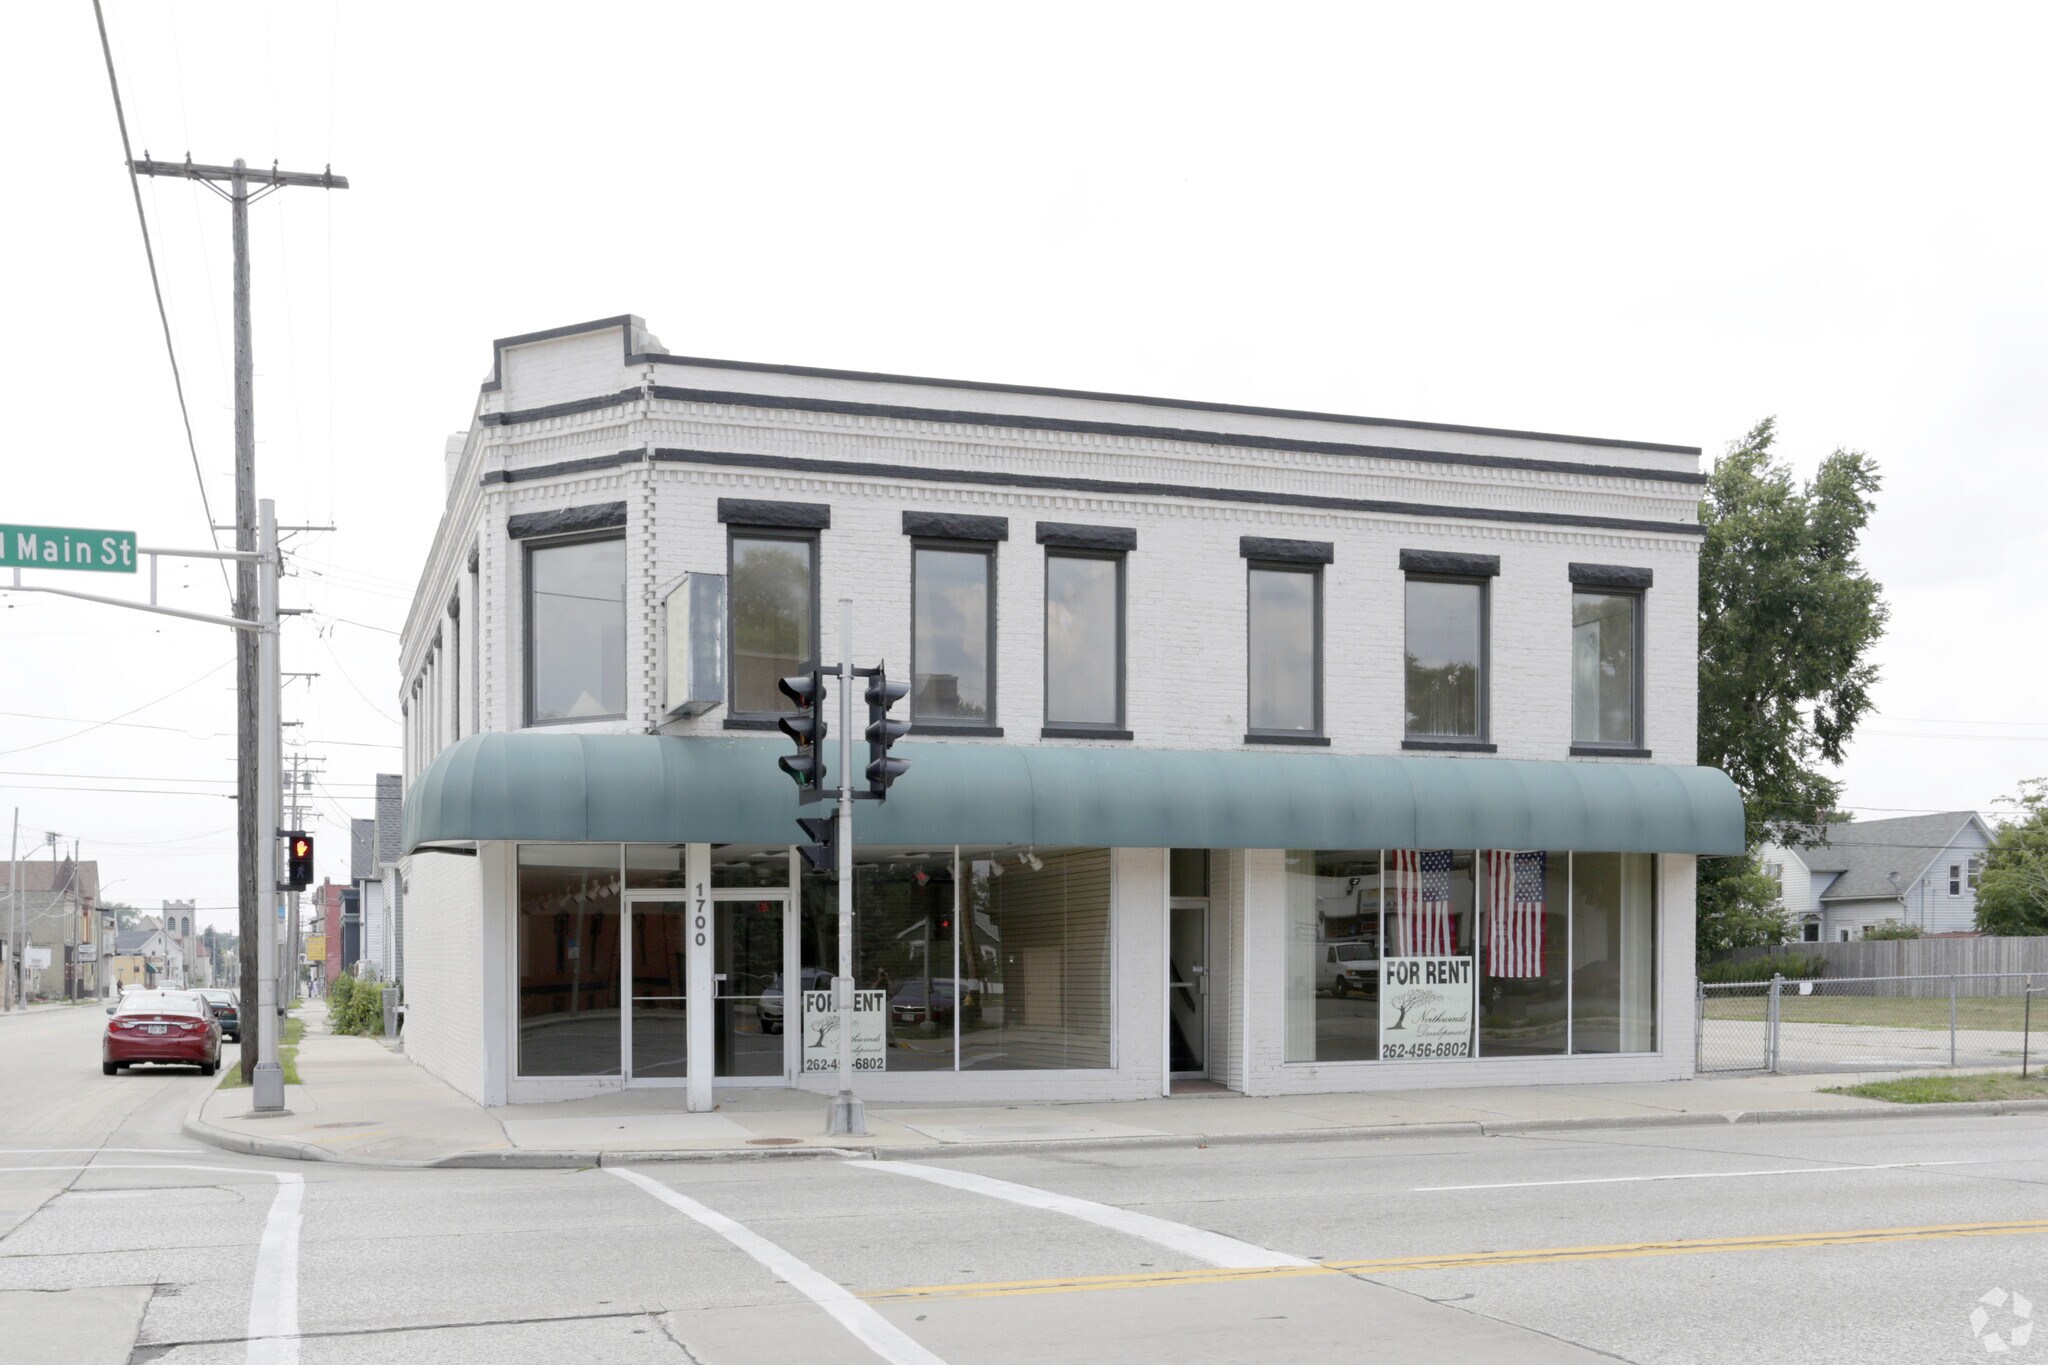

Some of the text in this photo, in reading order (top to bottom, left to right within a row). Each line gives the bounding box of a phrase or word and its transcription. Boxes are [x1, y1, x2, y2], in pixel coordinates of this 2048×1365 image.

[17, 532, 92, 564] Main
[100, 537, 132, 566] St
[695, 882, 706, 947] 1700
[1386, 960, 1471, 985] FOR RENT
[853, 993, 884, 1012] ENT
[1382, 1041, 1468, 1059] 262-456-6802
[806, 1057, 884, 1071] 262-4-6802
